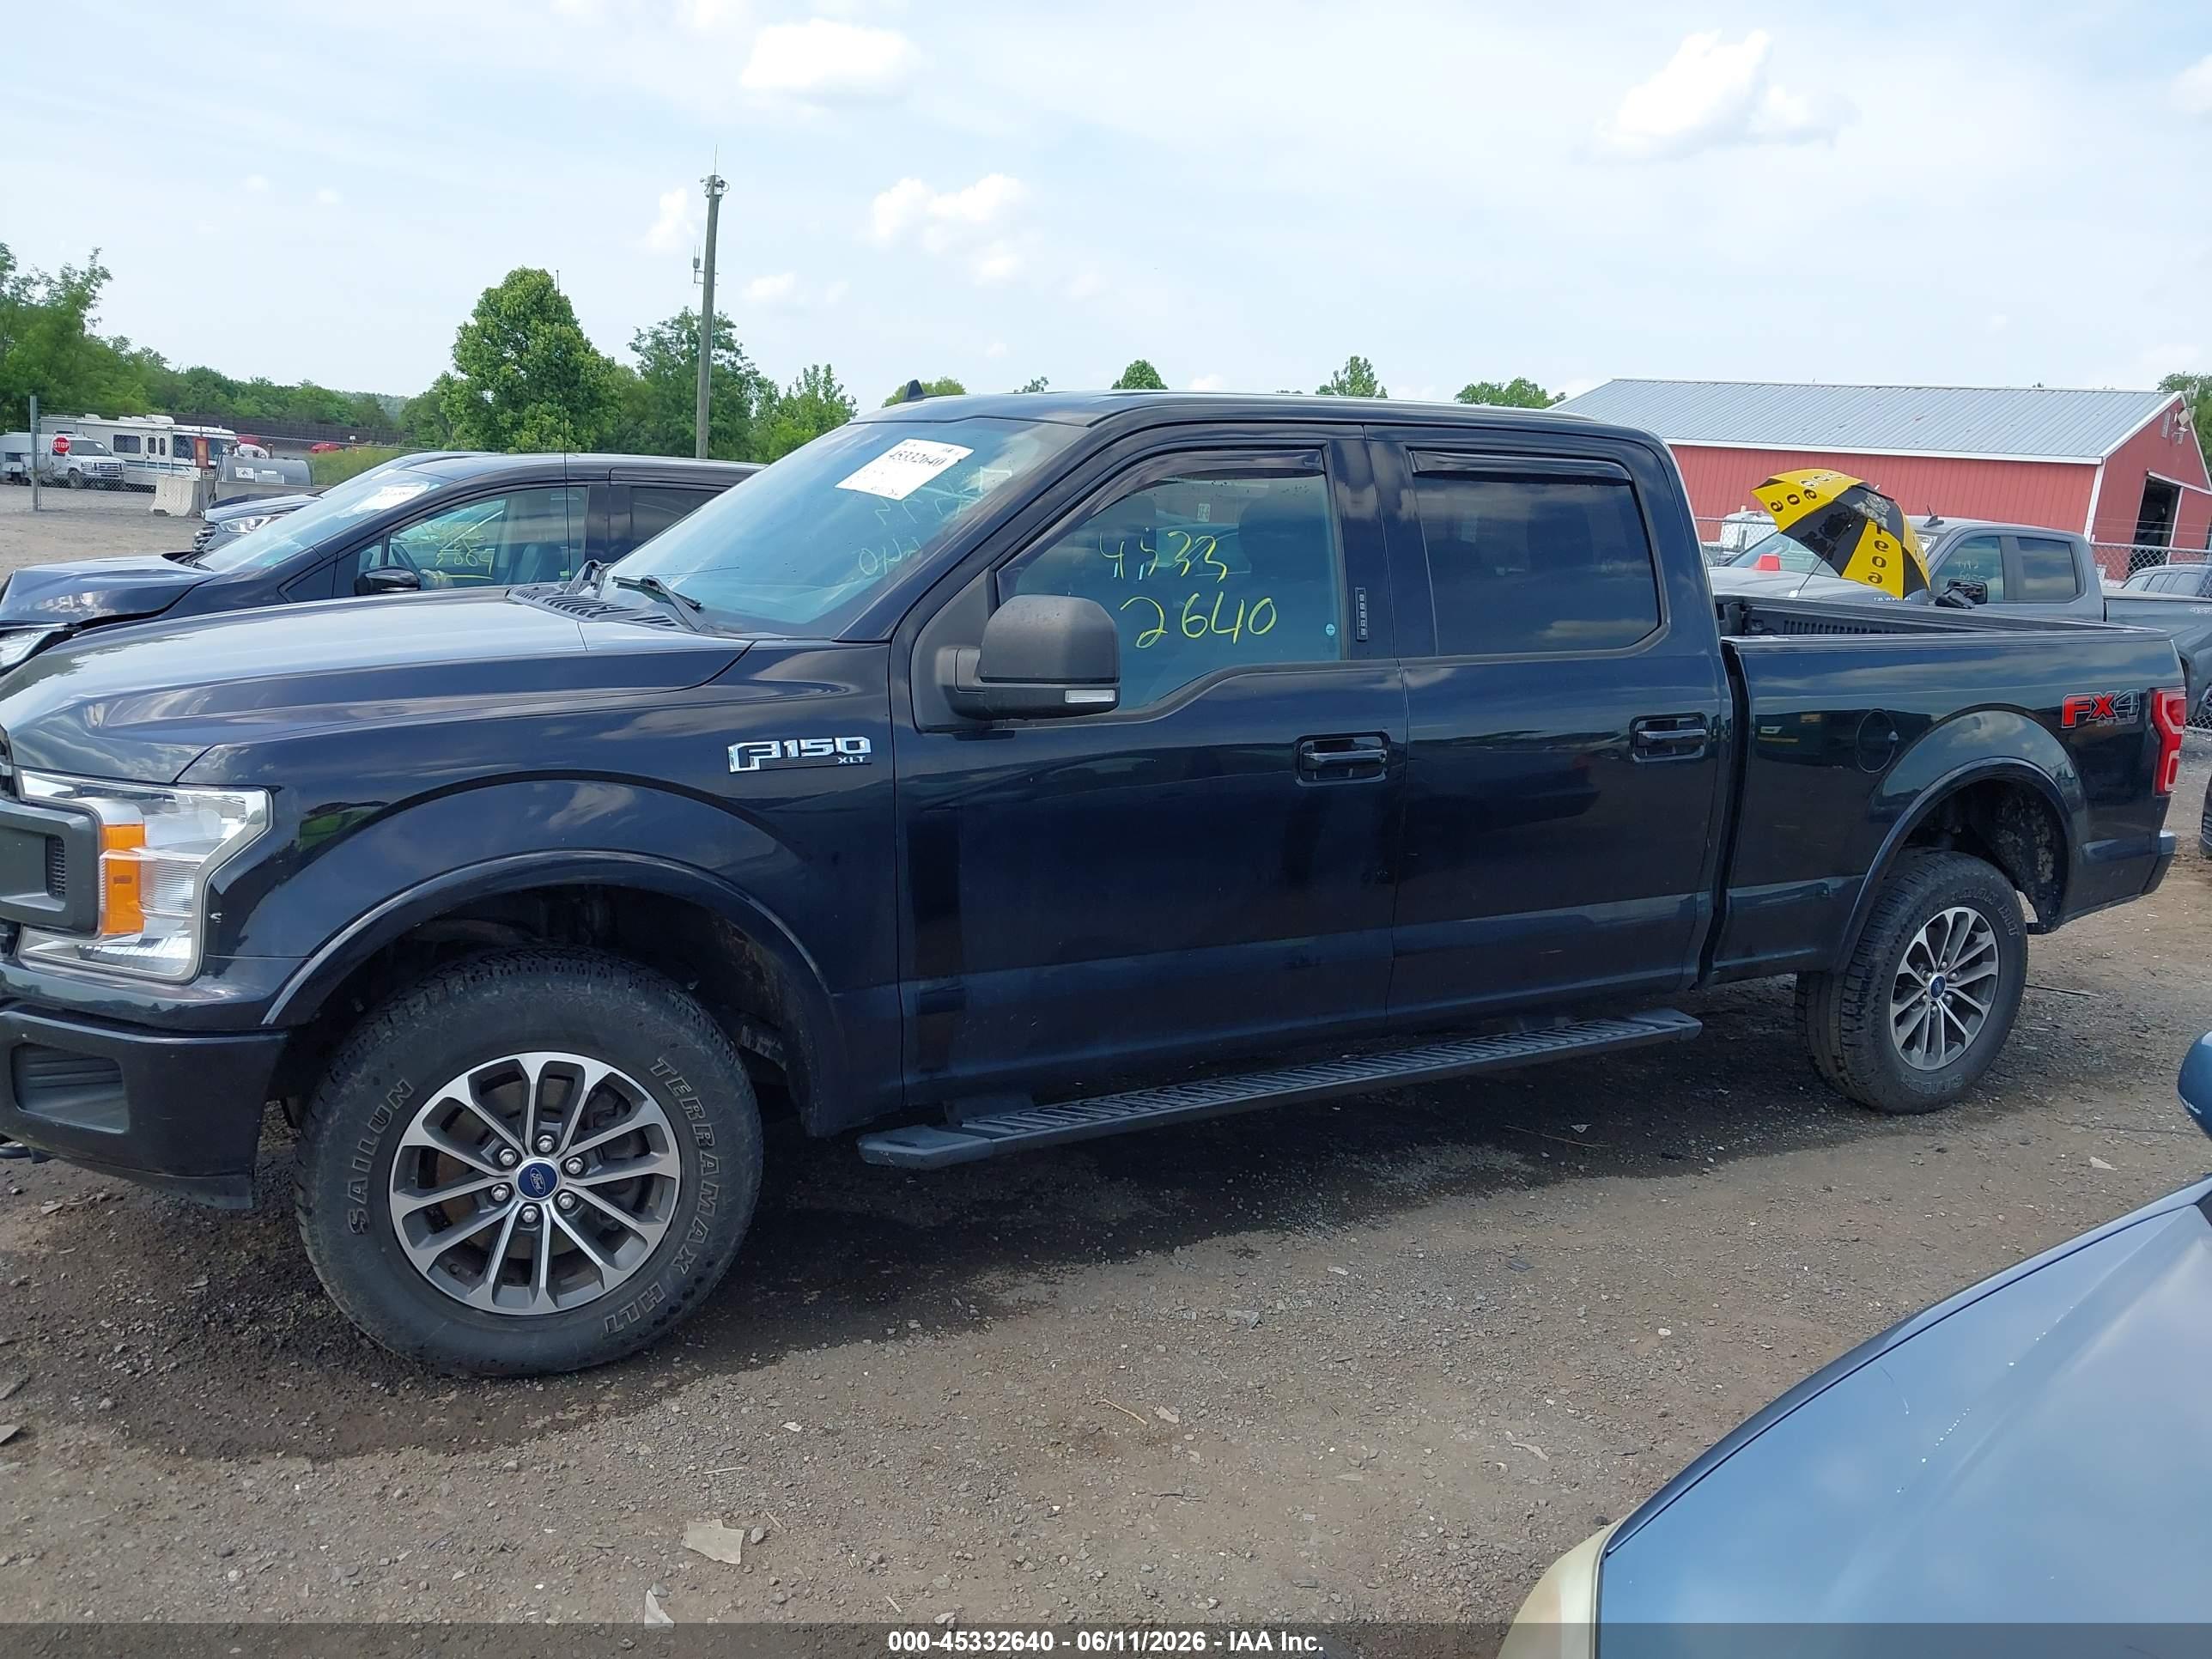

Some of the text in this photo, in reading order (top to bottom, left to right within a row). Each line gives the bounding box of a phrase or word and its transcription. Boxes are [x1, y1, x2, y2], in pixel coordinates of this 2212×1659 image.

[1120, 591, 1278, 648] 2640
[2062, 689, 2140, 729] FX4
[837, 756, 866, 764] XLT
[348, 1079, 414, 1234] SAILUN
[650, 1057, 720, 1275] TERRAMAX
